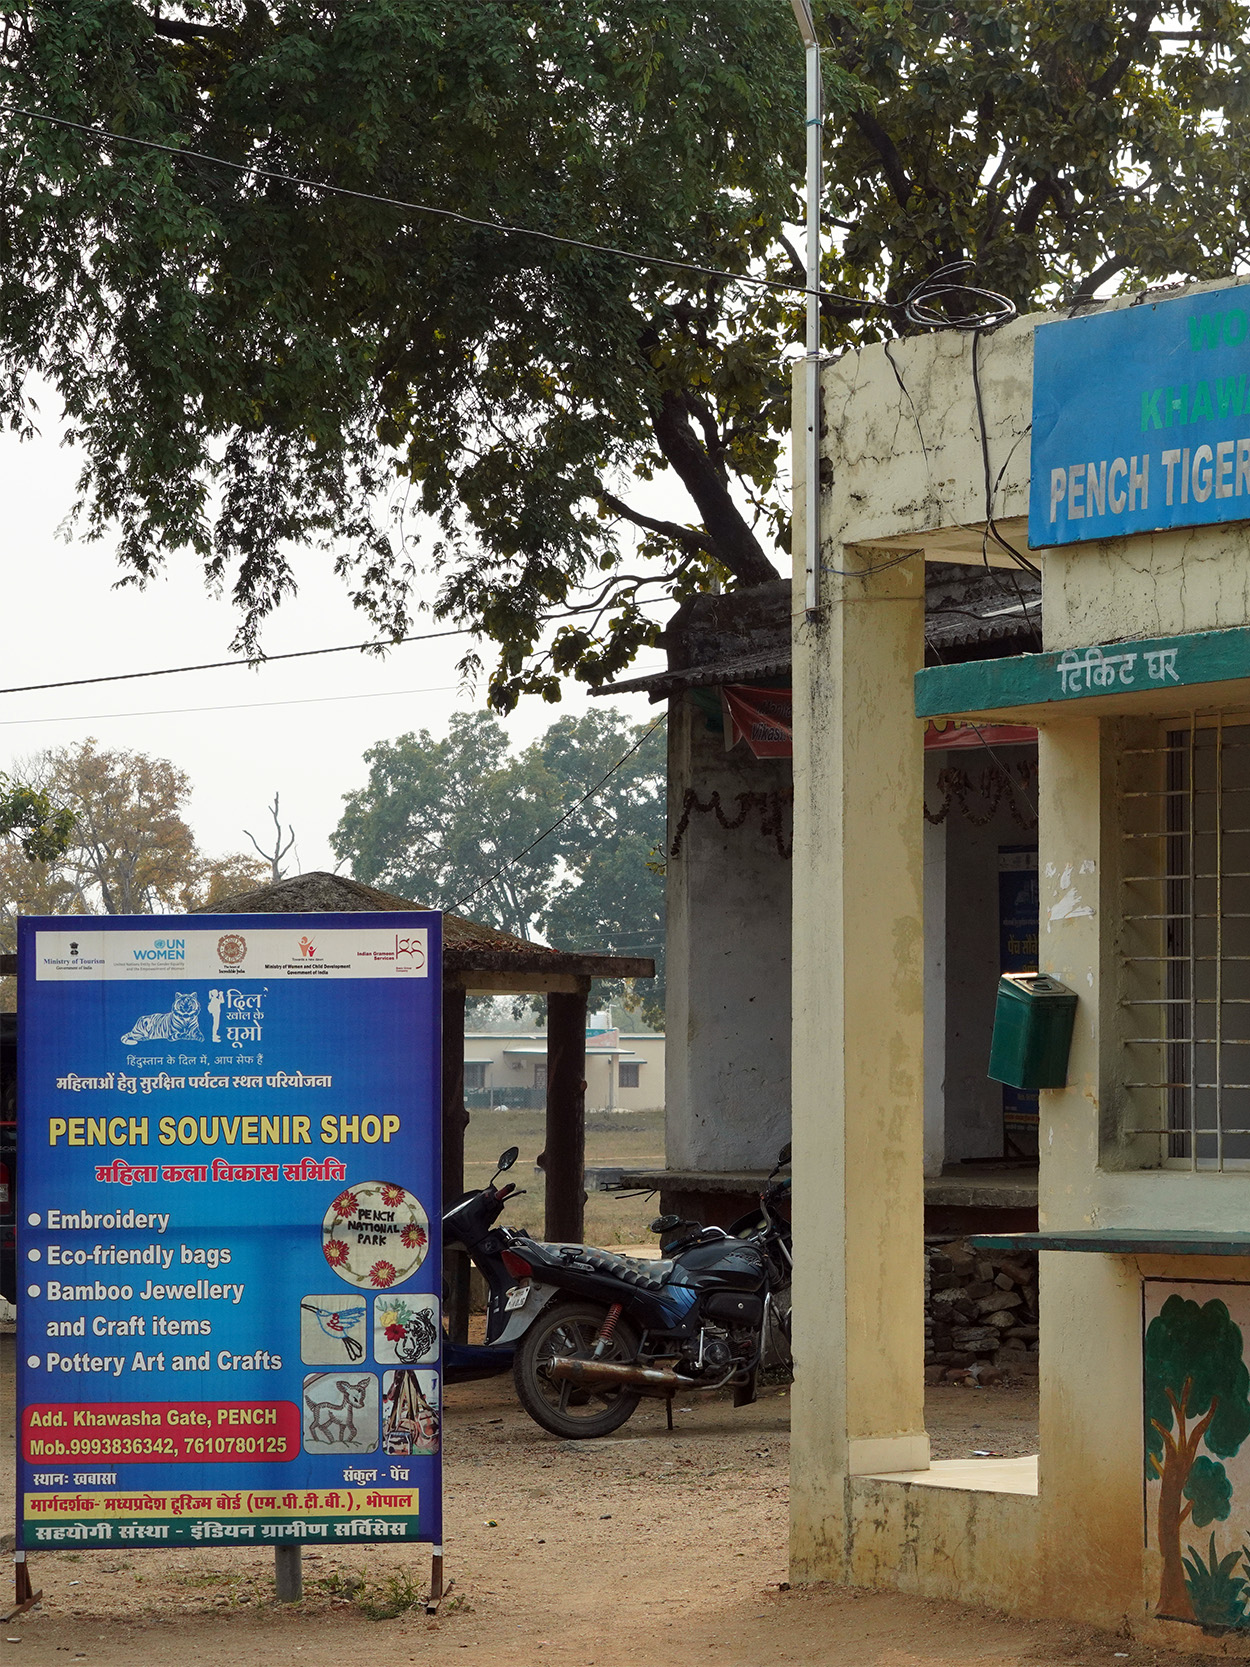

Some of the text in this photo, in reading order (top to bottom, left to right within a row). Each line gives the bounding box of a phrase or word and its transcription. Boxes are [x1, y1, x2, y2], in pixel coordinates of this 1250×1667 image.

[1050, 452, 1148, 523] PENCH
[1057, 648, 1180, 695] टिकिट घर
[167, 939, 185, 949] UN
[133, 950, 185, 961] WOMEN
[226, 989, 262, 1011] दिल
[226, 1008, 264, 1020] खोल के
[226, 1019, 263, 1048] घूमो
[126, 1055, 164, 1068] हिंदुस्तान
[166, 1055, 176, 1065] के
[178, 1054, 197, 1065] दिल
[213, 1055, 233, 1065] आप
[235, 1053, 255, 1065] सेफ
[256, 1052, 264, 1066] हैं
[56, 1070, 333, 1094] महिलाओं हेतु सुरक्षित पर्यटन स्थल परियोजना
[48, 1115, 401, 1147] PENCH SOUVENIR SHOP
[95, 1157, 346, 1185] महिला कला विकास समिति
[46, 1209, 170, 1234] Embroidery
[358, 1208, 395, 1222] PENCH
[347, 1220, 401, 1234] NATIONAL
[357, 1233, 387, 1247] PARK
[46, 1244, 232, 1271] Eco-friendly bags
[46, 1280, 245, 1305] Bamboo Jewellery
[46, 1315, 212, 1338] and Craft items
[46, 1350, 283, 1377] Pottery Art and Crafts
[30, 1408, 278, 1428] Add. Khawasha Gate, PENCH
[30, 1437, 288, 1457] Mob.9993836342, 7610780125
[73, 1471, 117, 1486] खबासा
[343, 1466, 410, 1483] संकुल पेंच
[31, 1496, 101, 1512] मार्गदर्शक-
[104, 1496, 167, 1512] मध्यप्रदेश
[170, 1494, 214, 1512] टूरिज्म
[216, 1493, 242, 1510] बोर्ड
[366, 1492, 412, 1509] भोपाल
[36, 1519, 407, 1540] सहयोगी संस्था इंडियन ग्रामीण सर्विसेस
